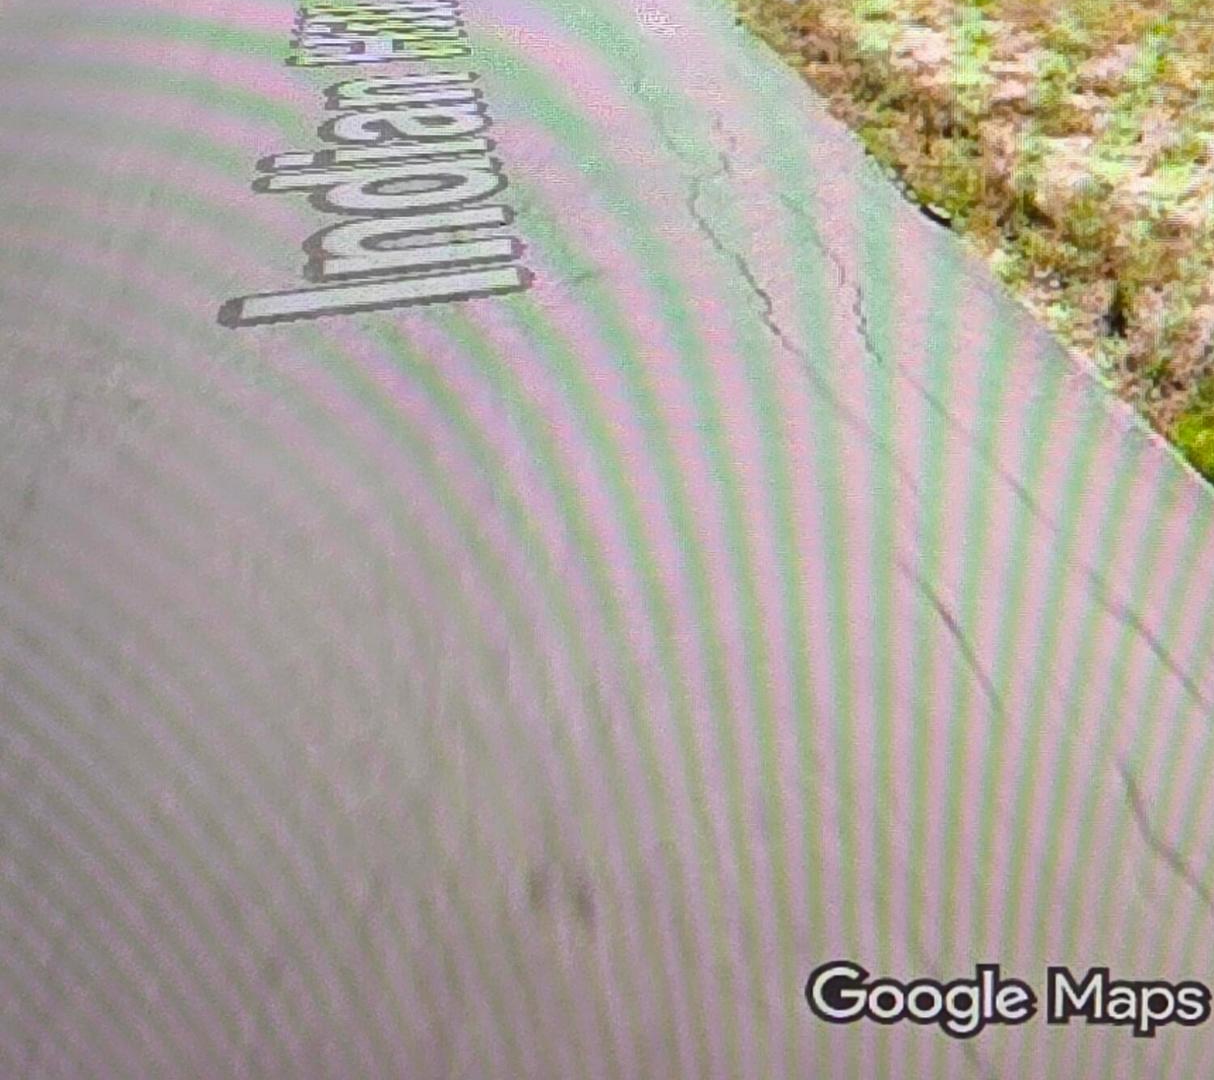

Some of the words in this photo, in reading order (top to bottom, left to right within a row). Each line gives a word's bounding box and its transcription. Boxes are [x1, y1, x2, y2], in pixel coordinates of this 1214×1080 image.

[218, 71, 536, 328] Indian
[807, 961, 1037, 1038] Google
[1048, 966, 1211, 1037] Maps
